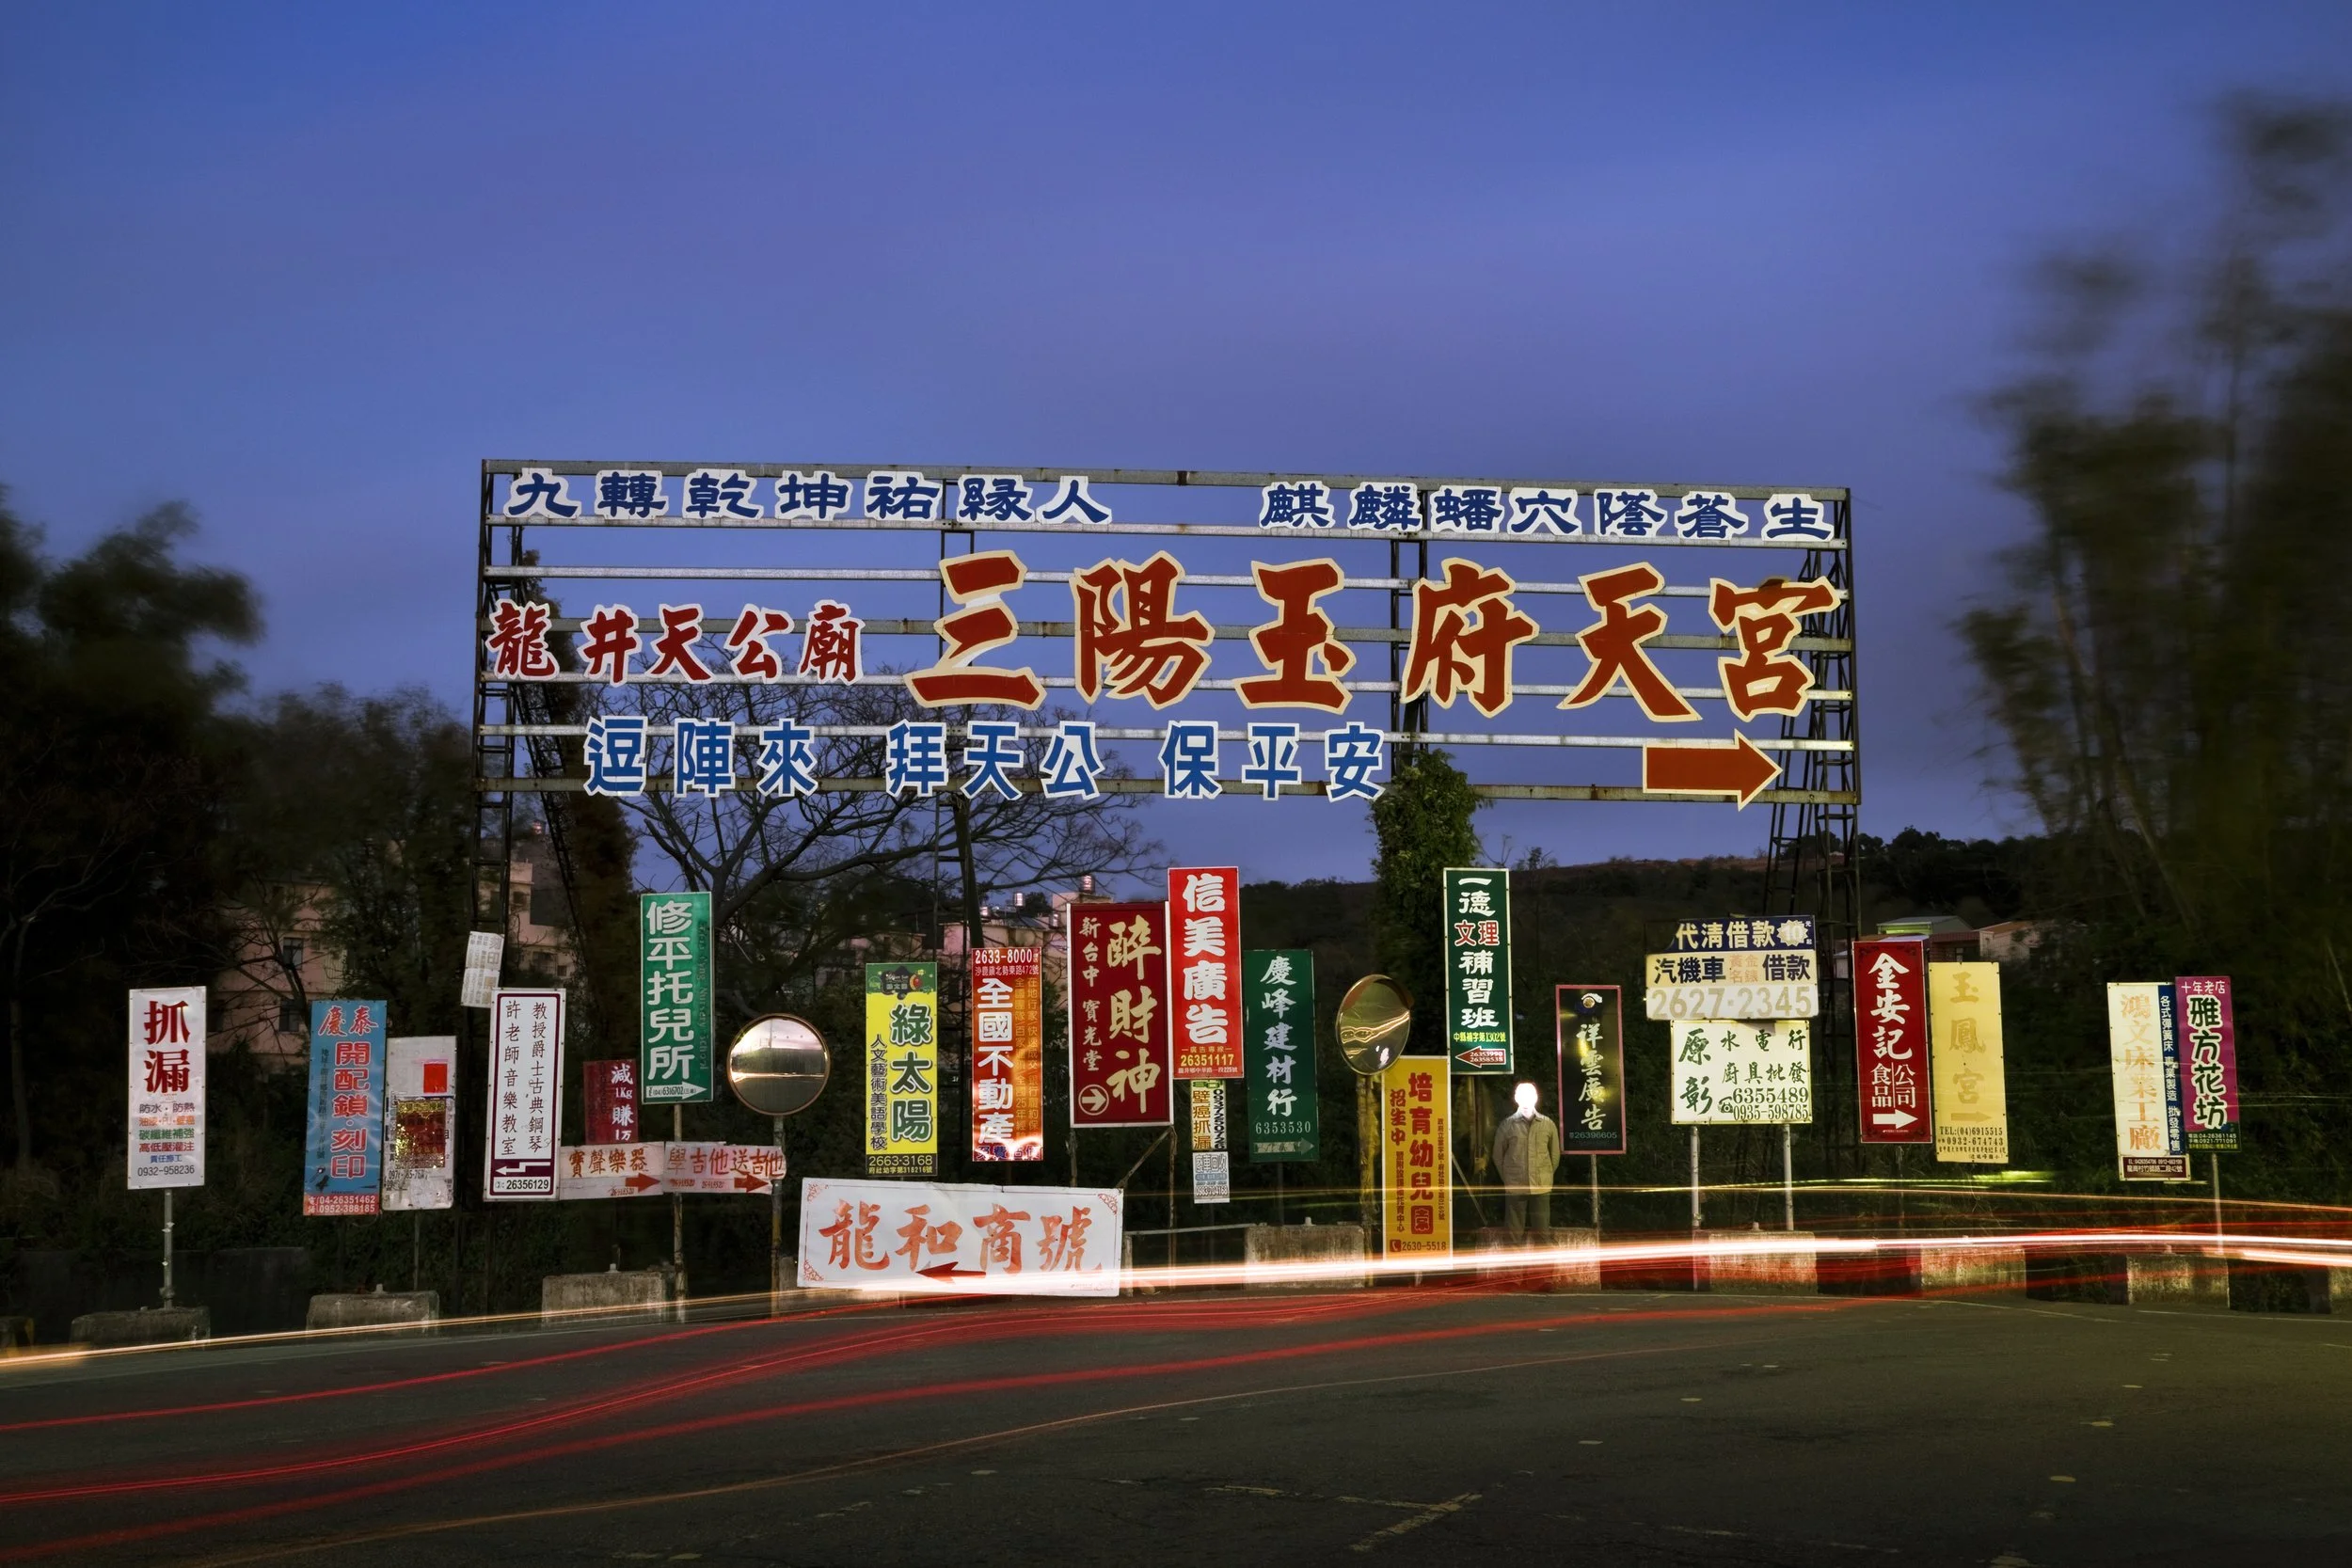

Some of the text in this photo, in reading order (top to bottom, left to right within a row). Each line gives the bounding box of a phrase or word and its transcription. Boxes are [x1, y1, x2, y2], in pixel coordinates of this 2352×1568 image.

[489, 601, 863, 685] 龍井天公廟
[910, 553, 1840, 721] 三陽玉府天宮
[586, 719, 1385, 801] 逗陣來 拜天公 保平安
[975, 948, 1033, 964] 2633-8000
[1182, 873, 1229, 1044] 信美廣告
[1675, 920, 1776, 950] 代清借款
[645, 900, 695, 1080] 修平托兒所
[1867, 952, 1914, 1060] 金安記
[143, 1000, 191, 1094] 抓漏
[501, 1000, 522, 1157] 許老師音樂教室
[528, 1002, 548, 1153] 教授爵士古典鋼琴
[889, 1003, 933, 1143] 綠太陽
[977, 977, 1014, 1145] 全國不動產
[1181, 1053, 1234, 1067] 26351117
[1677, 1028, 1714, 1116] 原彰
[1948, 971, 1987, 1105] 玉鳳宮
[2187, 993, 2227, 1131] 雅方花坊
[870, 1033, 888, 1152] 人文藝術美語學校
[1254, 1120, 1311, 1135] 6353530
[1389, 1088, 1406, 1147] 招生中
[1732, 1086, 1809, 1103] 6355489
[1733, 1103, 1808, 1121] 0935-598785
[137, 1165, 196, 1178] 0932-958236
[818, 1198, 1103, 1275] 龍和商號
[1402, 1241, 1447, 1252] 2630-5518
